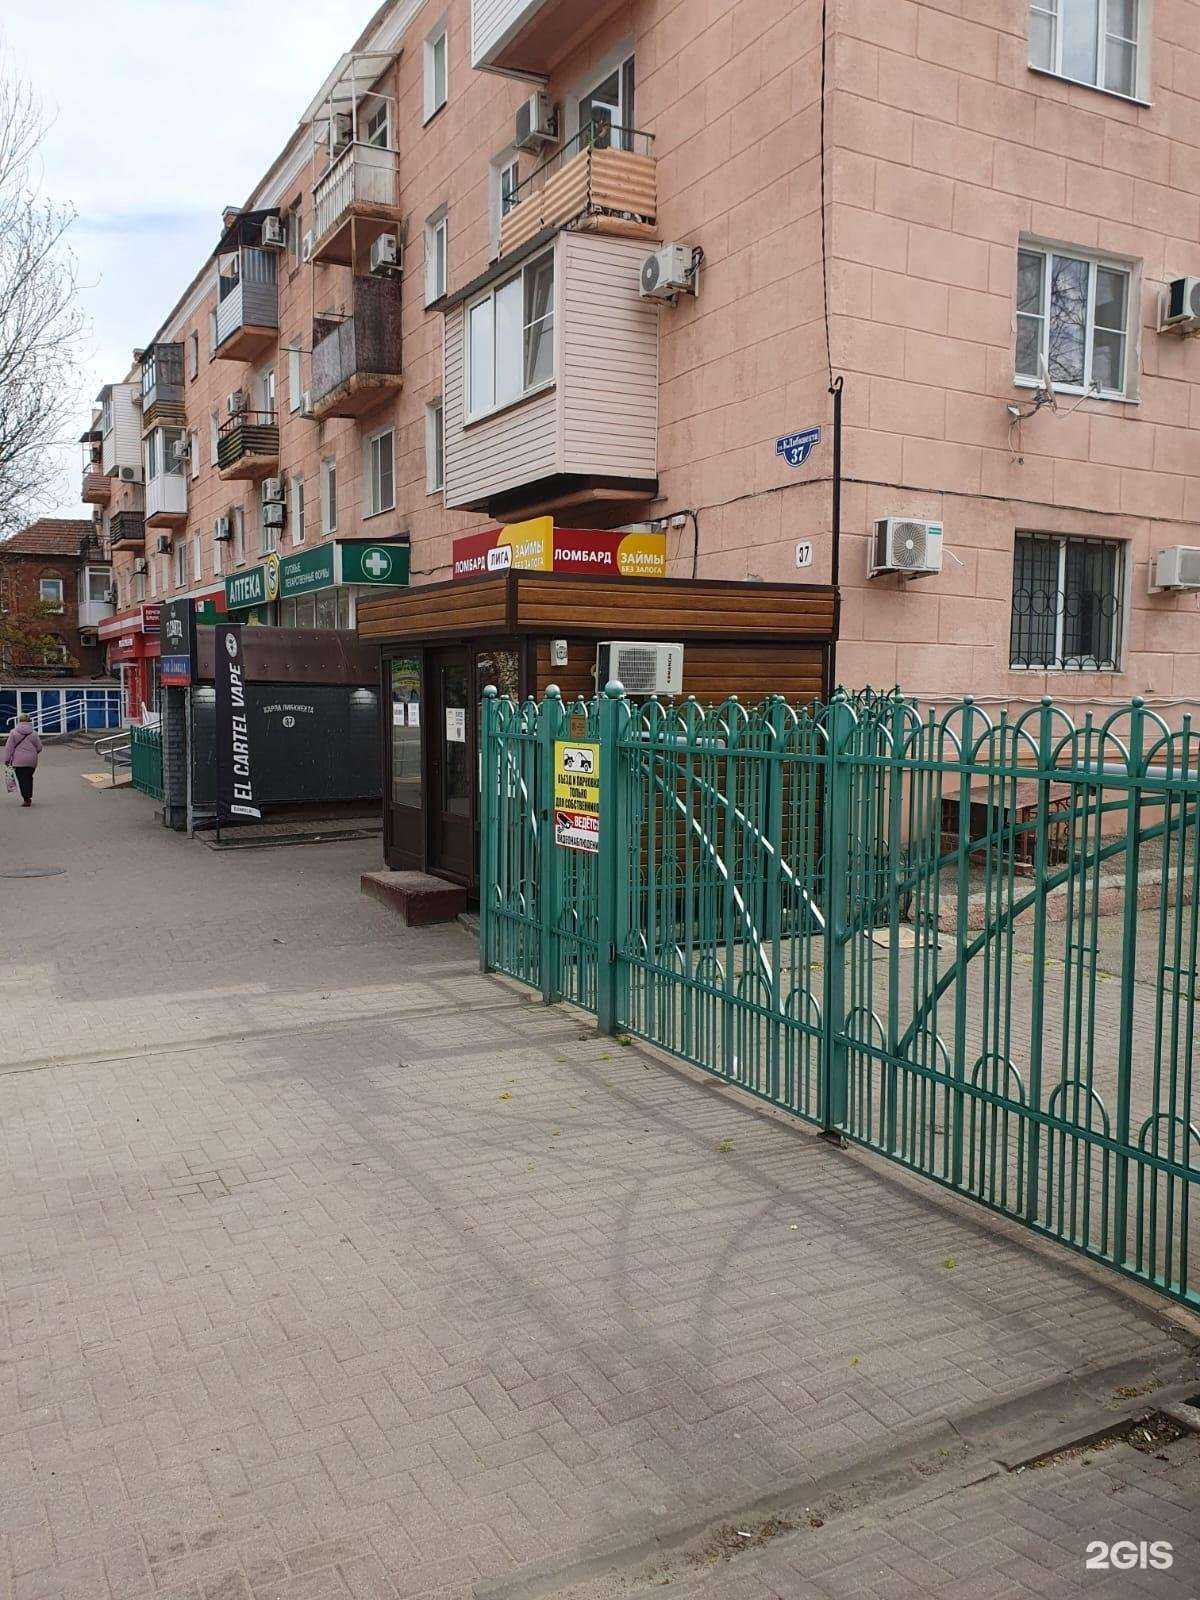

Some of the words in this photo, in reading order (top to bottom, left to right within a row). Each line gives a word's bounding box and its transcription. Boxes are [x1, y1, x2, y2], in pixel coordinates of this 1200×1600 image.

[791, 446, 804, 464] 37
[515, 539, 544, 558] ЗАЙМЫ
[555, 549, 612, 564] ЛОМБАРД
[800, 546, 810, 563] 37
[455, 556, 486, 574] ЛОМБАРД
[491, 550, 508, 566] ЛИГА
[621, 551, 664, 565] ЗАЙМЫ
[635, 566, 662, 574] ЗАЛОГА
[230, 573, 261, 604] АПТЕКА
[229, 662, 246, 708] VAPE
[232, 713, 250, 777] CARTEL
[234, 781, 253, 801] EL
[570, 787, 587, 799] ТОЛЬКО
